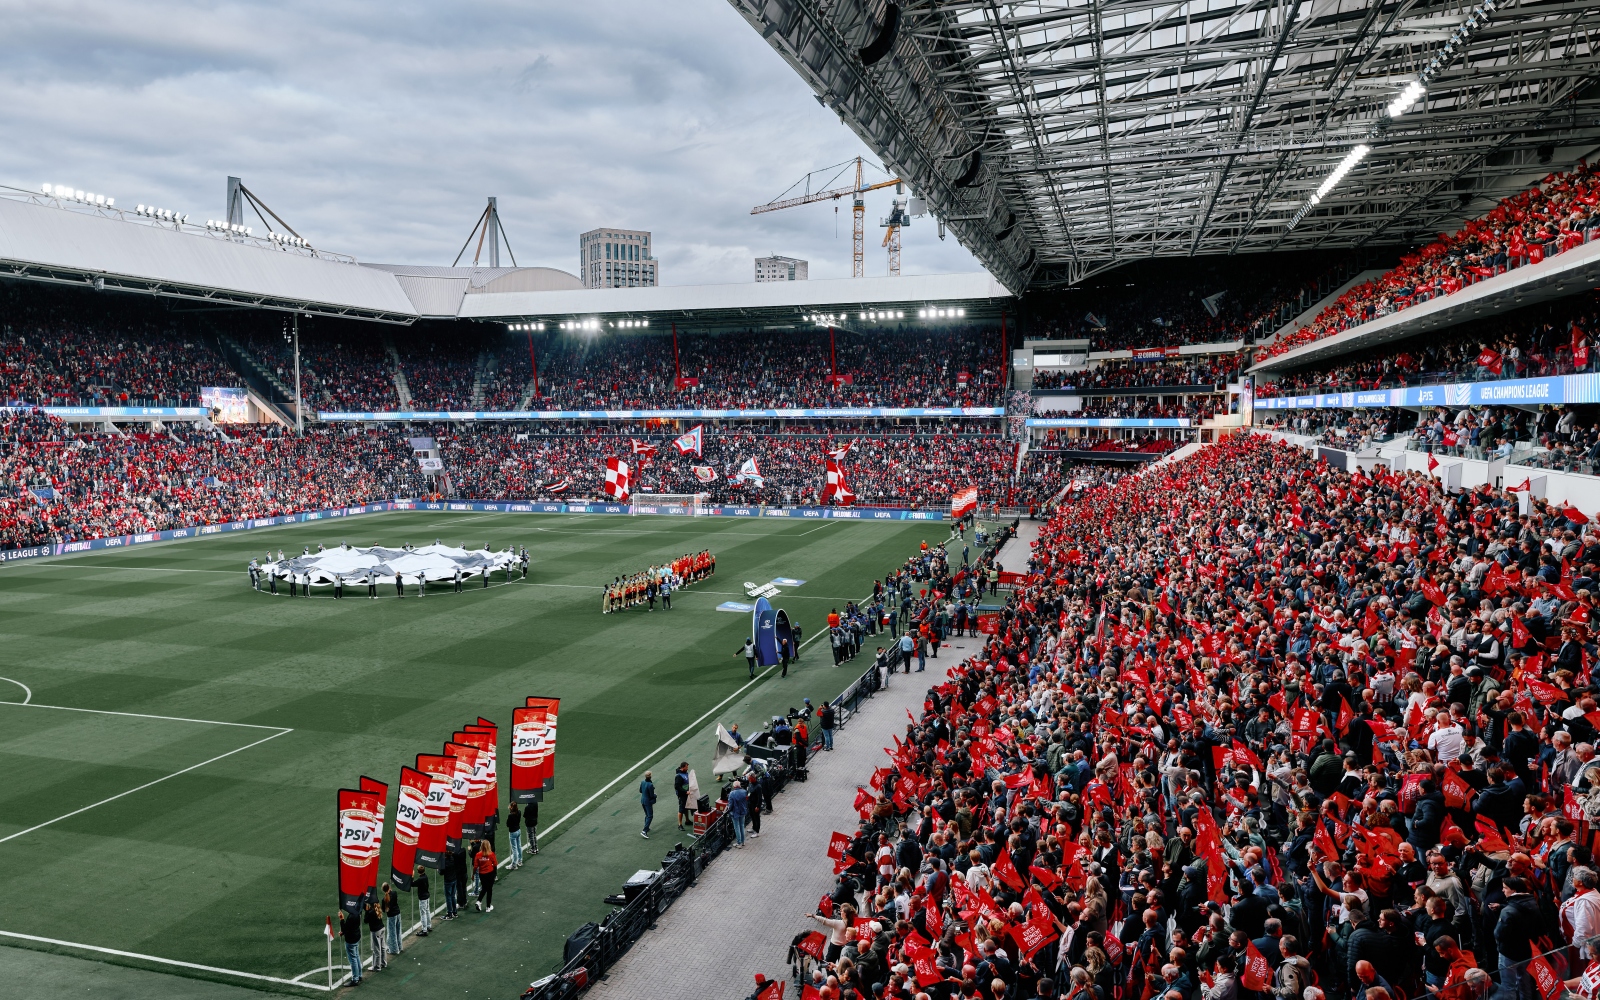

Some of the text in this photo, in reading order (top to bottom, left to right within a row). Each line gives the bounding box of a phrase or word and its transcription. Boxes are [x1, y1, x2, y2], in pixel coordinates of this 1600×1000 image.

[1480, 384, 1549, 399] UEFA CHAMPIONS LEAGUE
[64, 541, 91, 552] #FOOTBALL
[105, 538, 122, 547] UEFA
[8, 548, 38, 560] LEAGUE
[518, 738, 540, 747] PSV
[453, 779, 465, 790] SV
[428, 791, 445, 802] SV
[399, 803, 419, 820] PSV
[344, 828, 370, 841] PSV
[1022, 925, 1036, 937] EVERY
[1023, 928, 1040, 942] MOMENT
